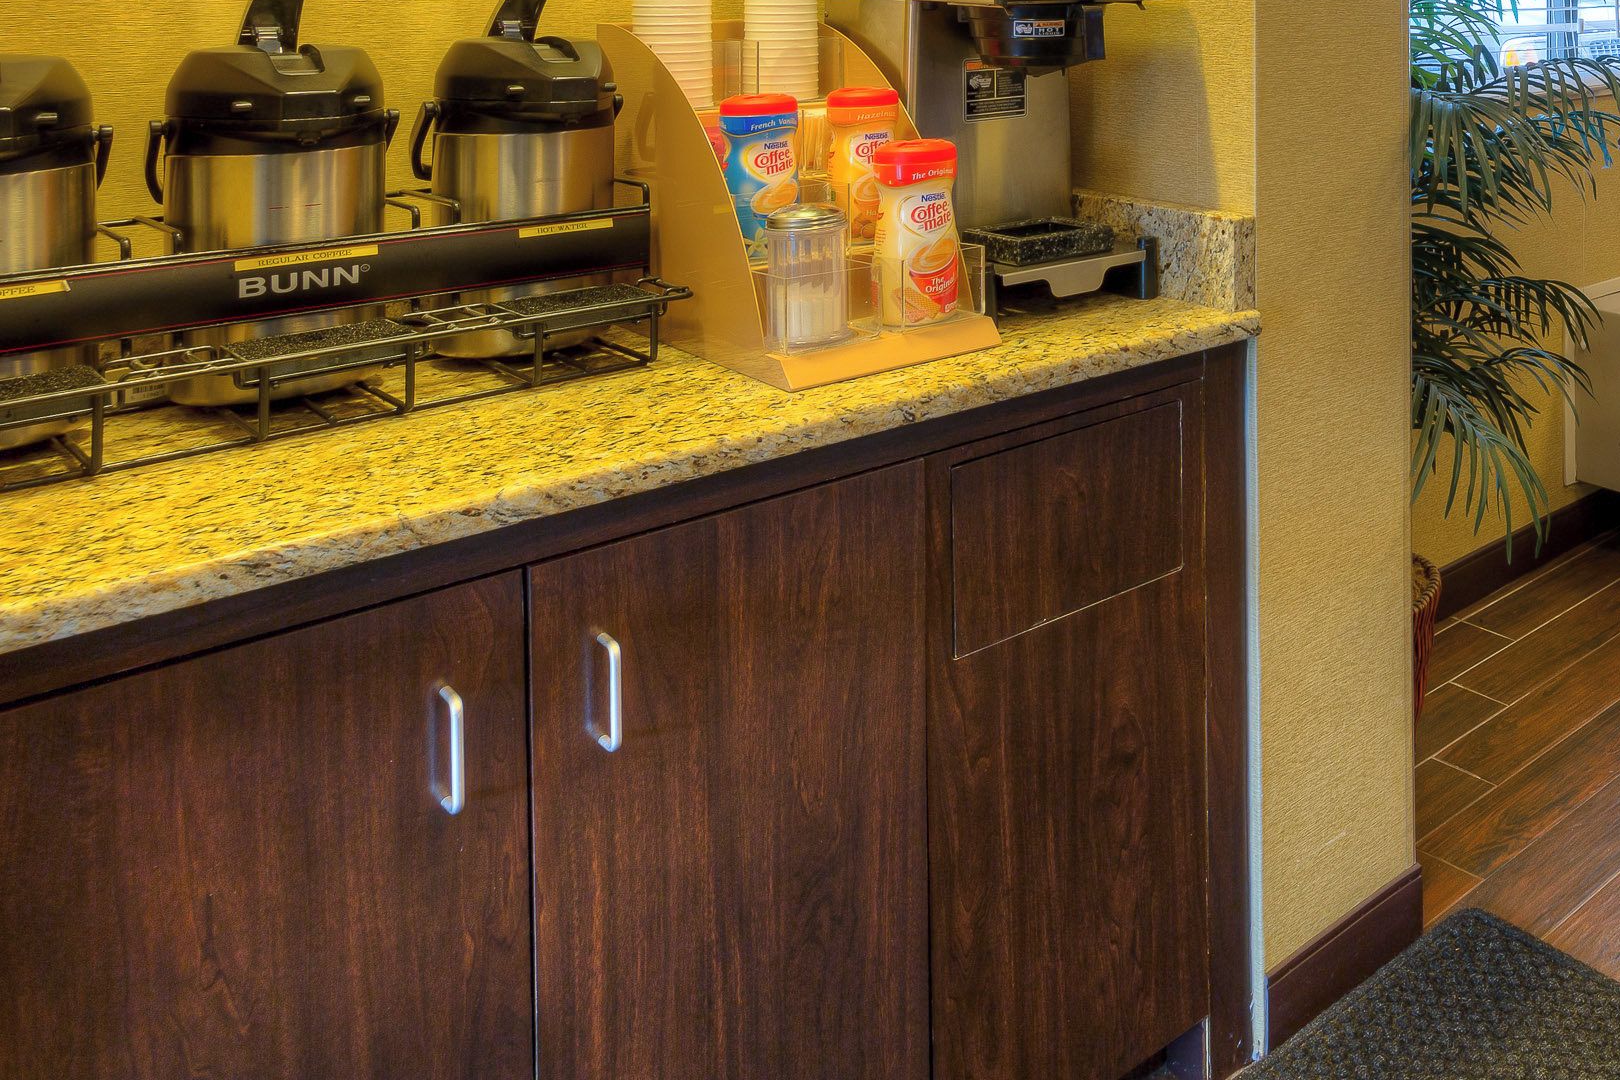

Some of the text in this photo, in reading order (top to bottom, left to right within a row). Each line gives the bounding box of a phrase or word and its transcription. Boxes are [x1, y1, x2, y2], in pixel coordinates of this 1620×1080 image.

[751, 120, 776, 132] French
[754, 148, 790, 169] Coffee
[766, 158, 794, 175] mate
[912, 172, 926, 181] The
[910, 200, 949, 224] Coffee
[923, 211, 951, 232] mate
[537, 223, 588, 234] HOT WATER
[257, 248, 353, 267] REGULAR COFFEE
[238, 264, 360, 299] BUNN
[925, 272, 956, 294] Original
[931, 276, 944, 285] The
